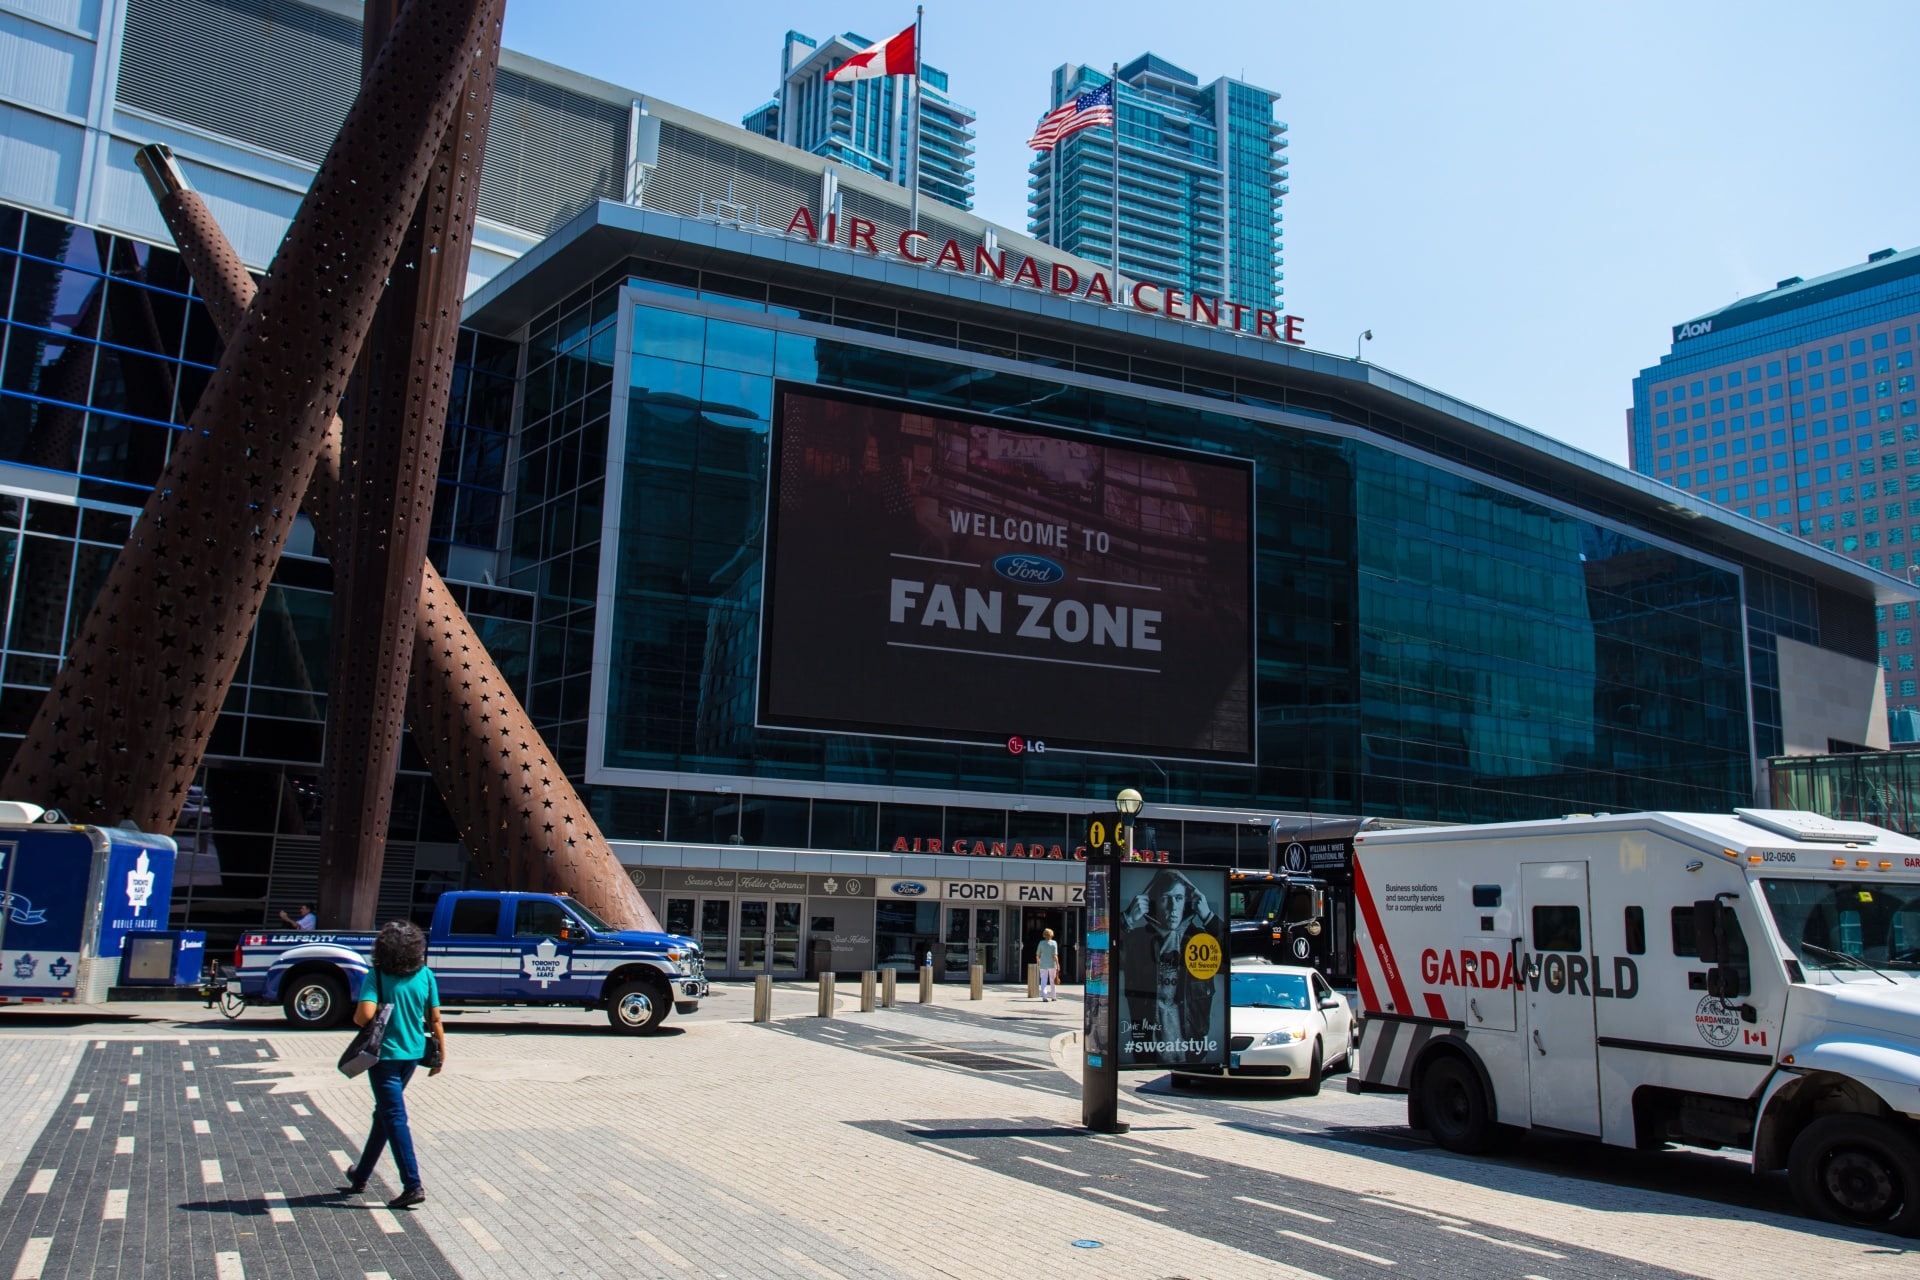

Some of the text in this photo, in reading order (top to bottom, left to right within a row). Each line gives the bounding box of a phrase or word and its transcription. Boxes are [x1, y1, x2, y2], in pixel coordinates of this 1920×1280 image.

[785, 206, 1306, 345] AIR CANADA CENTRE
[950, 510, 1110, 554] WELCOME TO
[1007, 557, 1050, 582] Ford
[889, 579, 1162, 652] FAN ZONE
[1026, 740, 1045, 753] LG
[893, 836, 942, 853] AIR
[952, 839, 1064, 860] CANADA
[1762, 852, 1796, 862] U2-0506
[714, 876, 733, 887] Seat
[769, 878, 805, 890] Entrance
[897, 884, 920, 895] Ford
[1385, 883, 1438, 892] Business solutions
[949, 883, 999, 900] FORD
[1019, 886, 1053, 901] FAN
[1385, 893, 1445, 903] and security services
[1385, 903, 1394, 911] for
[1399, 903, 1424, 913] complex
[1424, 903, 1442, 912] world
[271, 935, 311, 943] LEAFS
[1124, 1036, 1217, 1055] #sweatstyle
